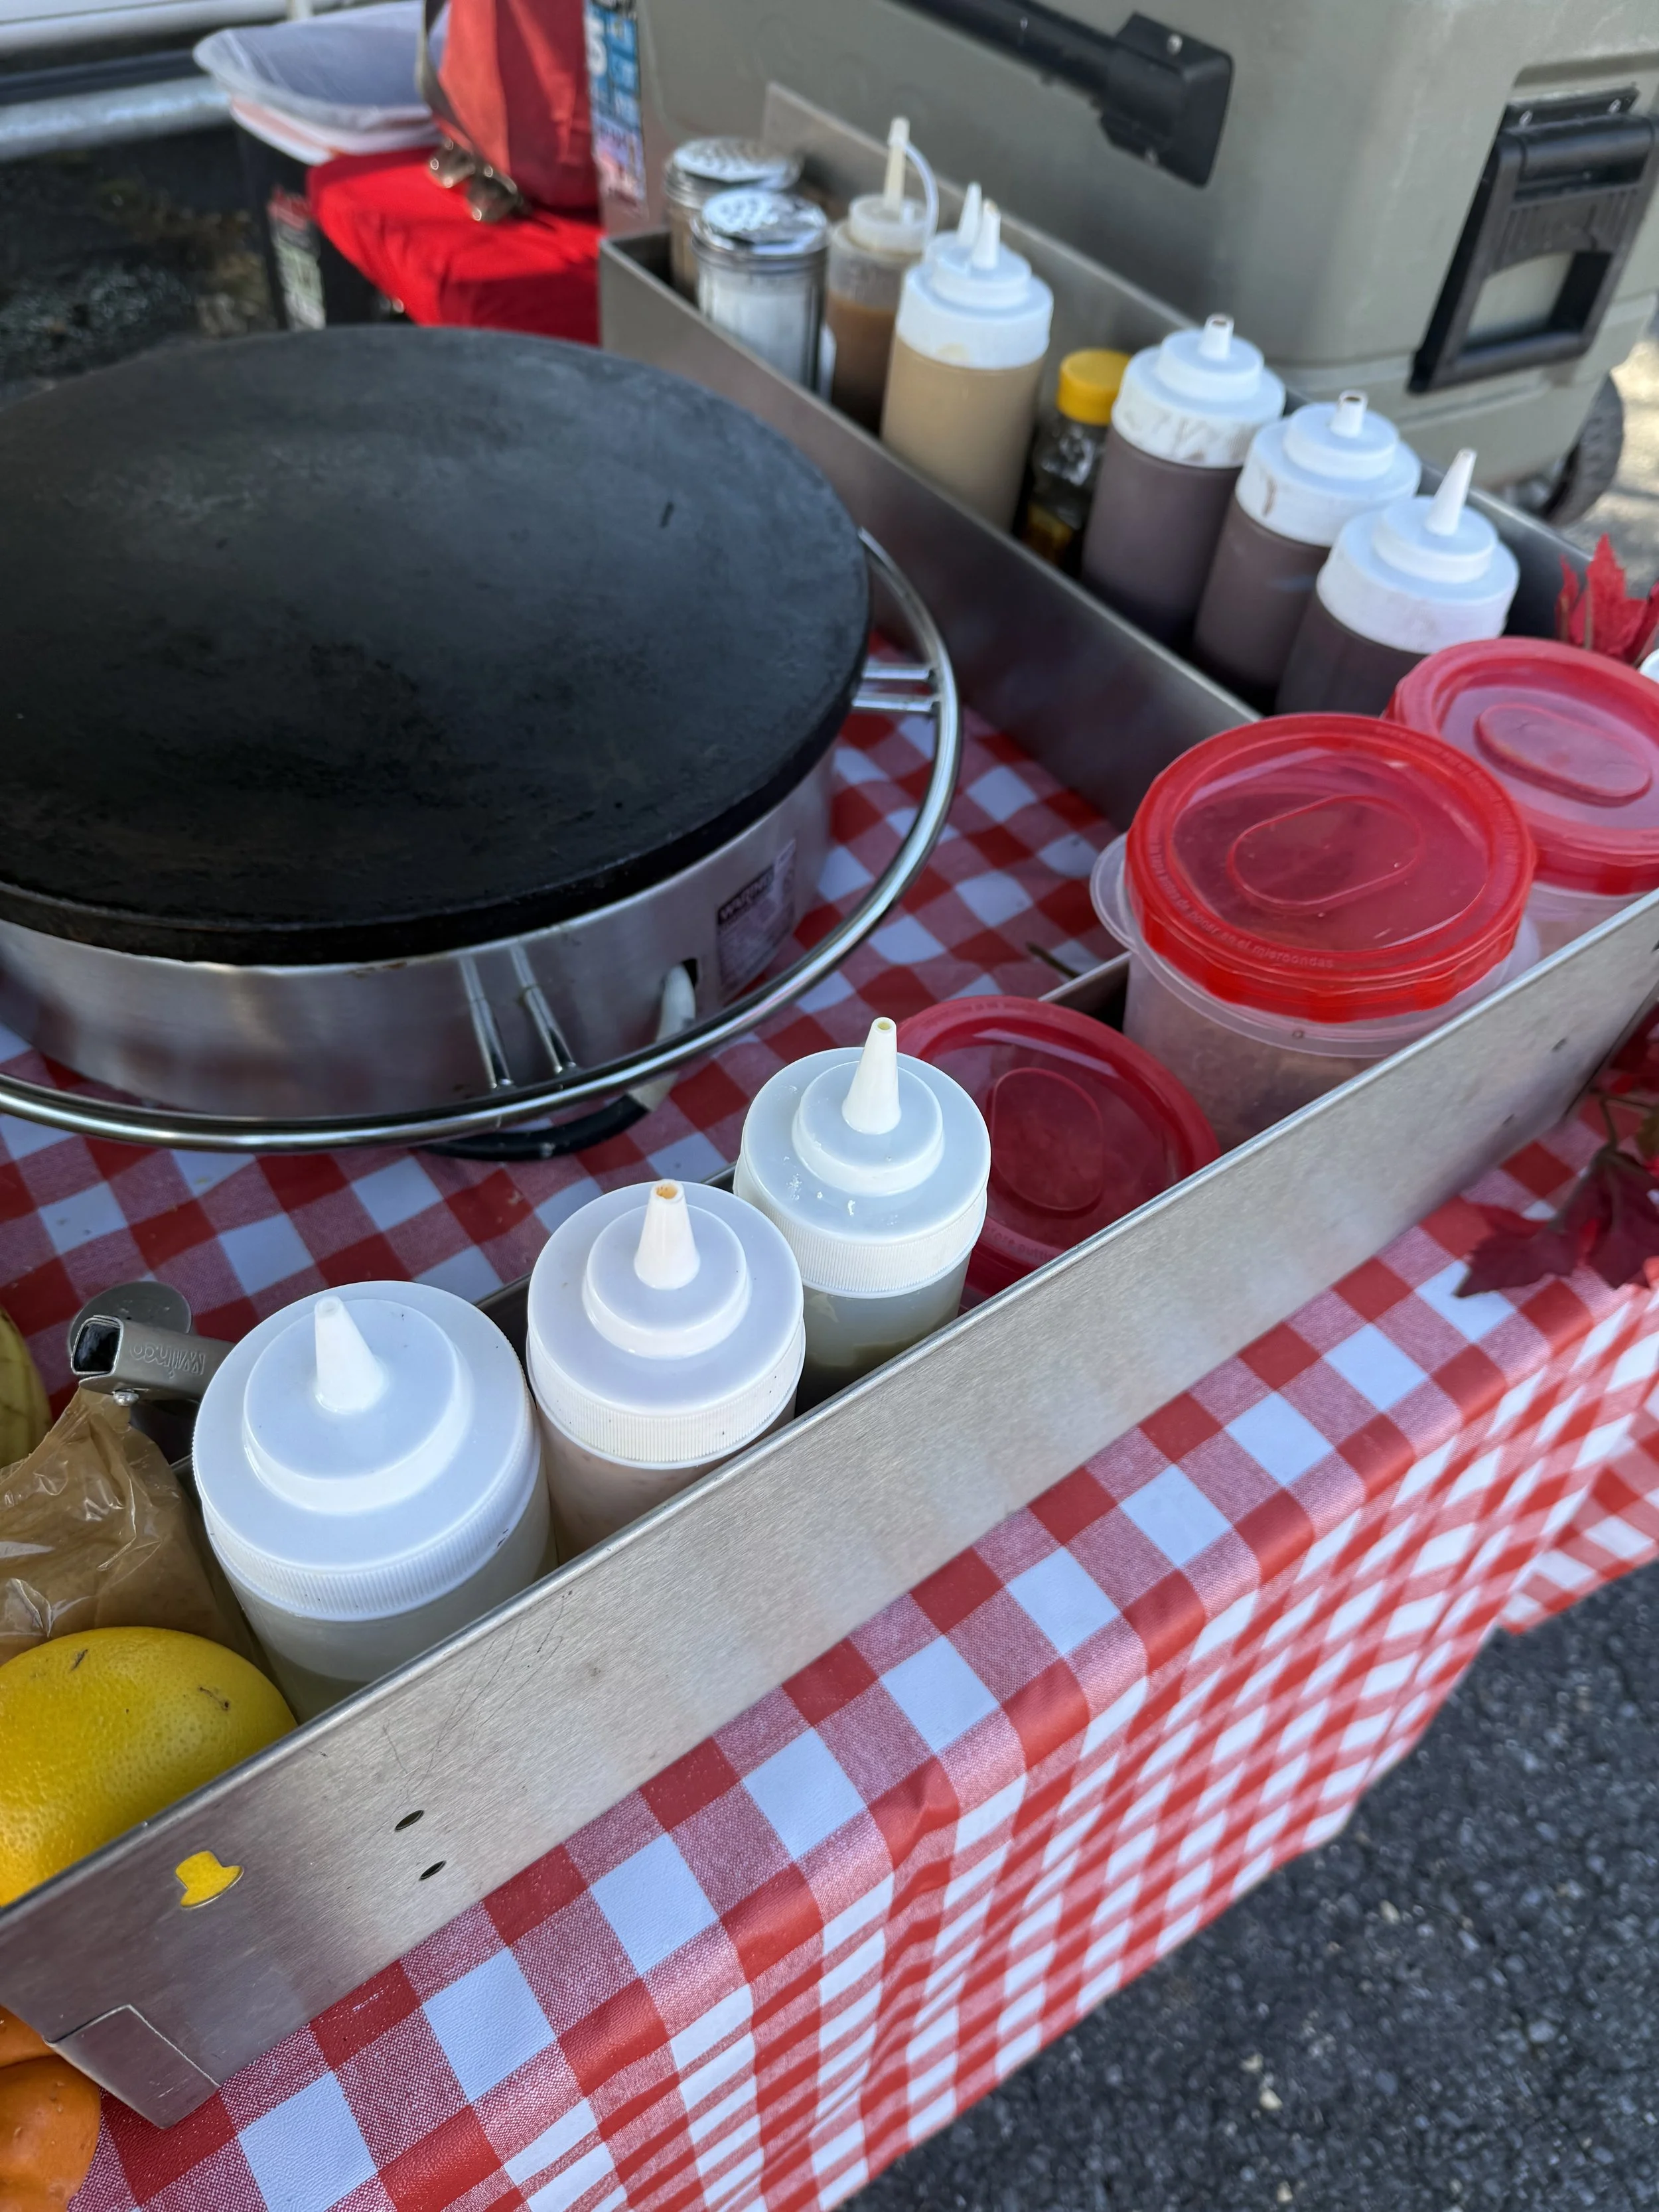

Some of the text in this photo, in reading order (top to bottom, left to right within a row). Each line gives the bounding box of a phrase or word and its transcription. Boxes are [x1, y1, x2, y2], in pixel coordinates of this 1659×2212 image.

[1187, 909, 1220, 935] poner
[1252, 944, 1334, 969] microondas
[984, 1225, 1015, 1248] efore
